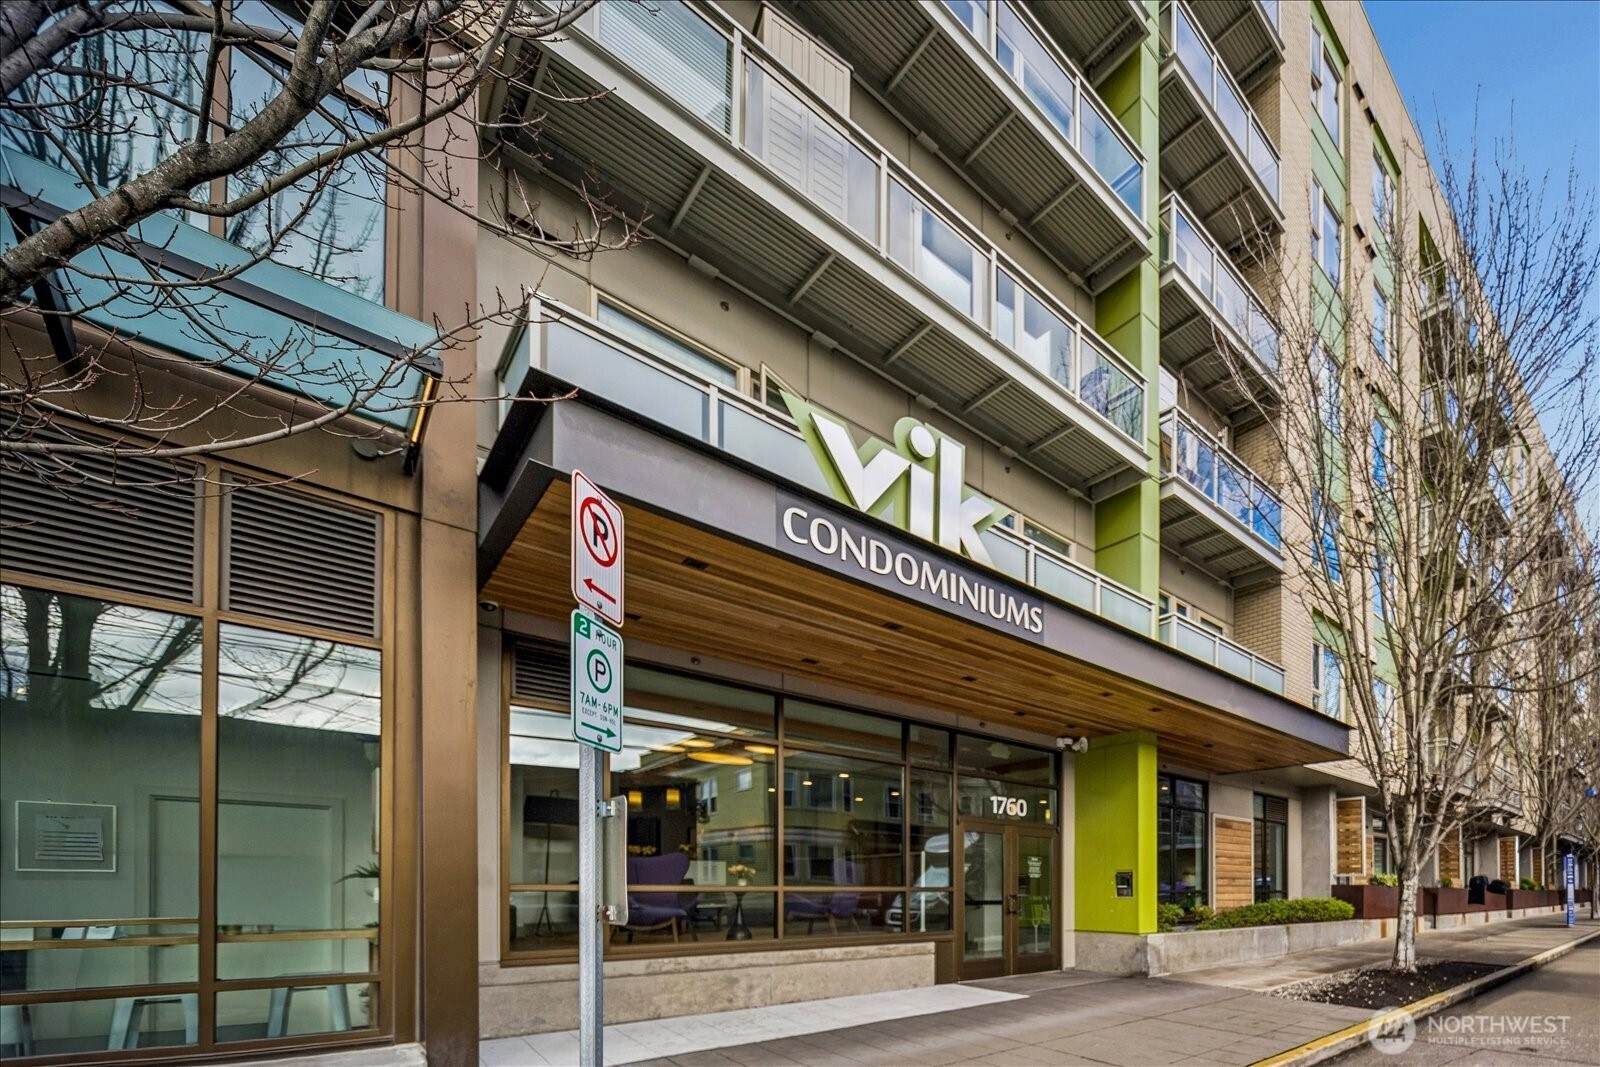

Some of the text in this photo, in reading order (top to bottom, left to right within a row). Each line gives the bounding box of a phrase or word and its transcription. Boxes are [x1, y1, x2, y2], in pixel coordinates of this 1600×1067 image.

[807, 411, 998, 569] vik
[592, 511, 609, 548] P
[783, 506, 1043, 634] CONDOMINIUMS
[579, 617, 618, 651] 2 HOUR
[595, 658, 607, 683] P
[990, 796, 1027, 817] 1760
